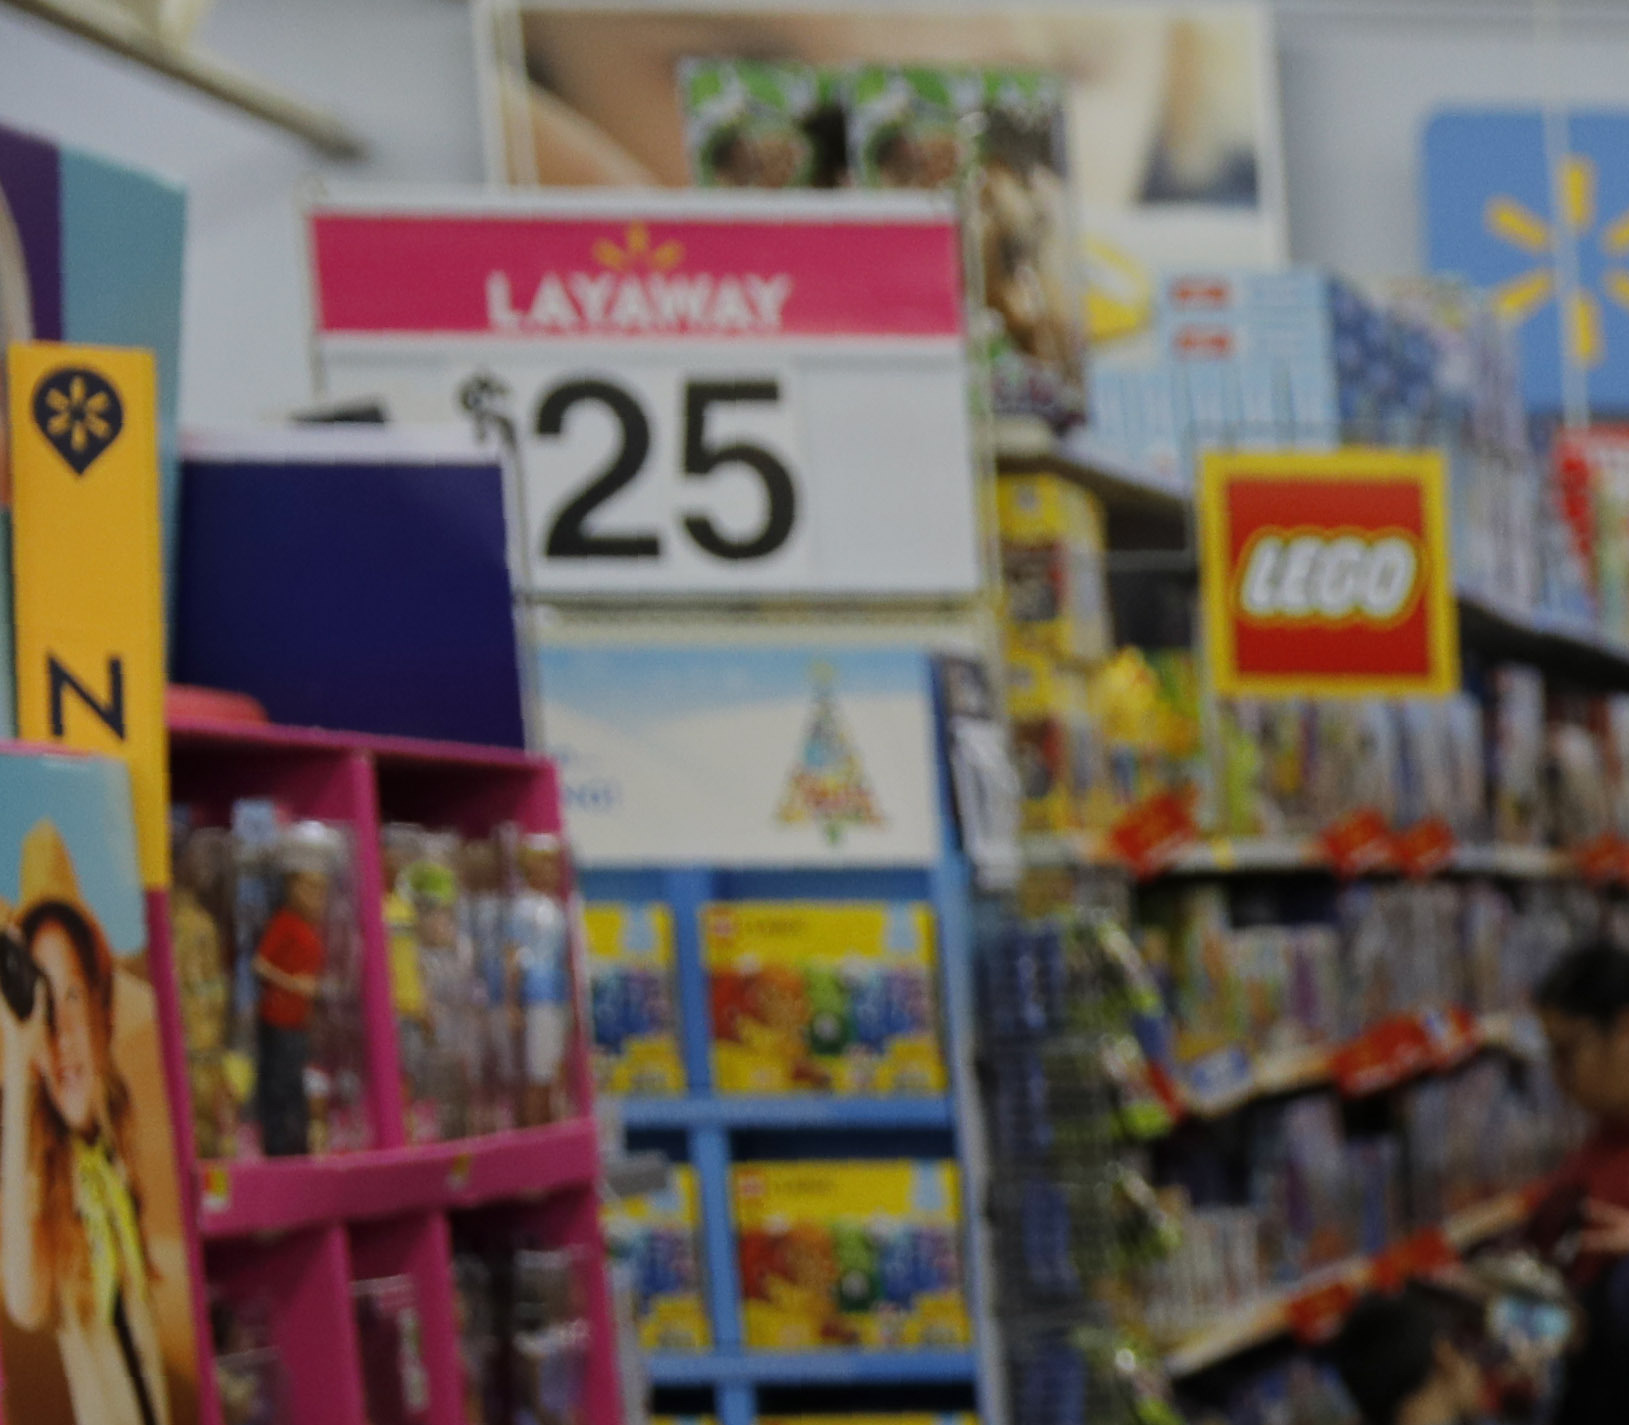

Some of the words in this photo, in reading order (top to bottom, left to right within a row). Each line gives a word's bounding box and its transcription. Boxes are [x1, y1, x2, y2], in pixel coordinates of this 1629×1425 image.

[485, 270, 791, 331] LAYAWAY
[1237, 532, 1421, 619] LEGO
[48, 654, 125, 742] N
